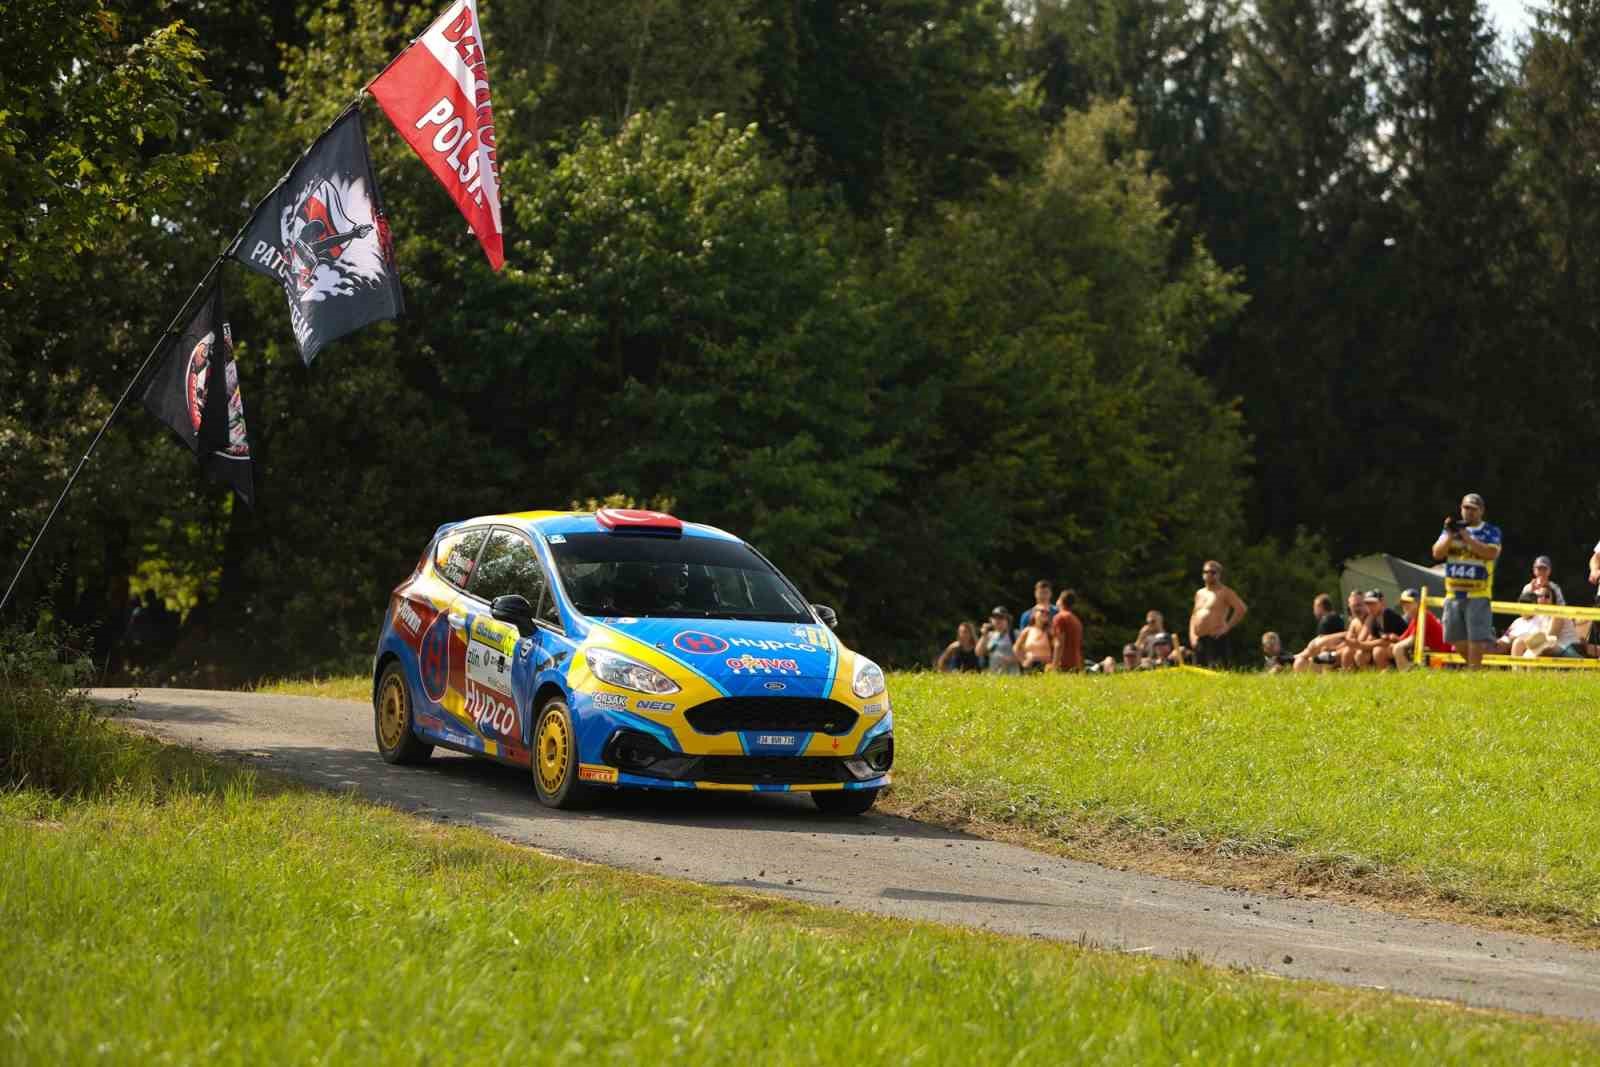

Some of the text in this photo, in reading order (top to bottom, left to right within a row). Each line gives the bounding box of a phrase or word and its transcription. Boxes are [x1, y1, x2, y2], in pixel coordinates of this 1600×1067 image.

[415, 96, 482, 208] POLSK
[1449, 566, 1476, 578] 144
[729, 638, 817, 653] Hypco
[464, 677, 515, 736] Hypco
[636, 700, 676, 710] NEO
